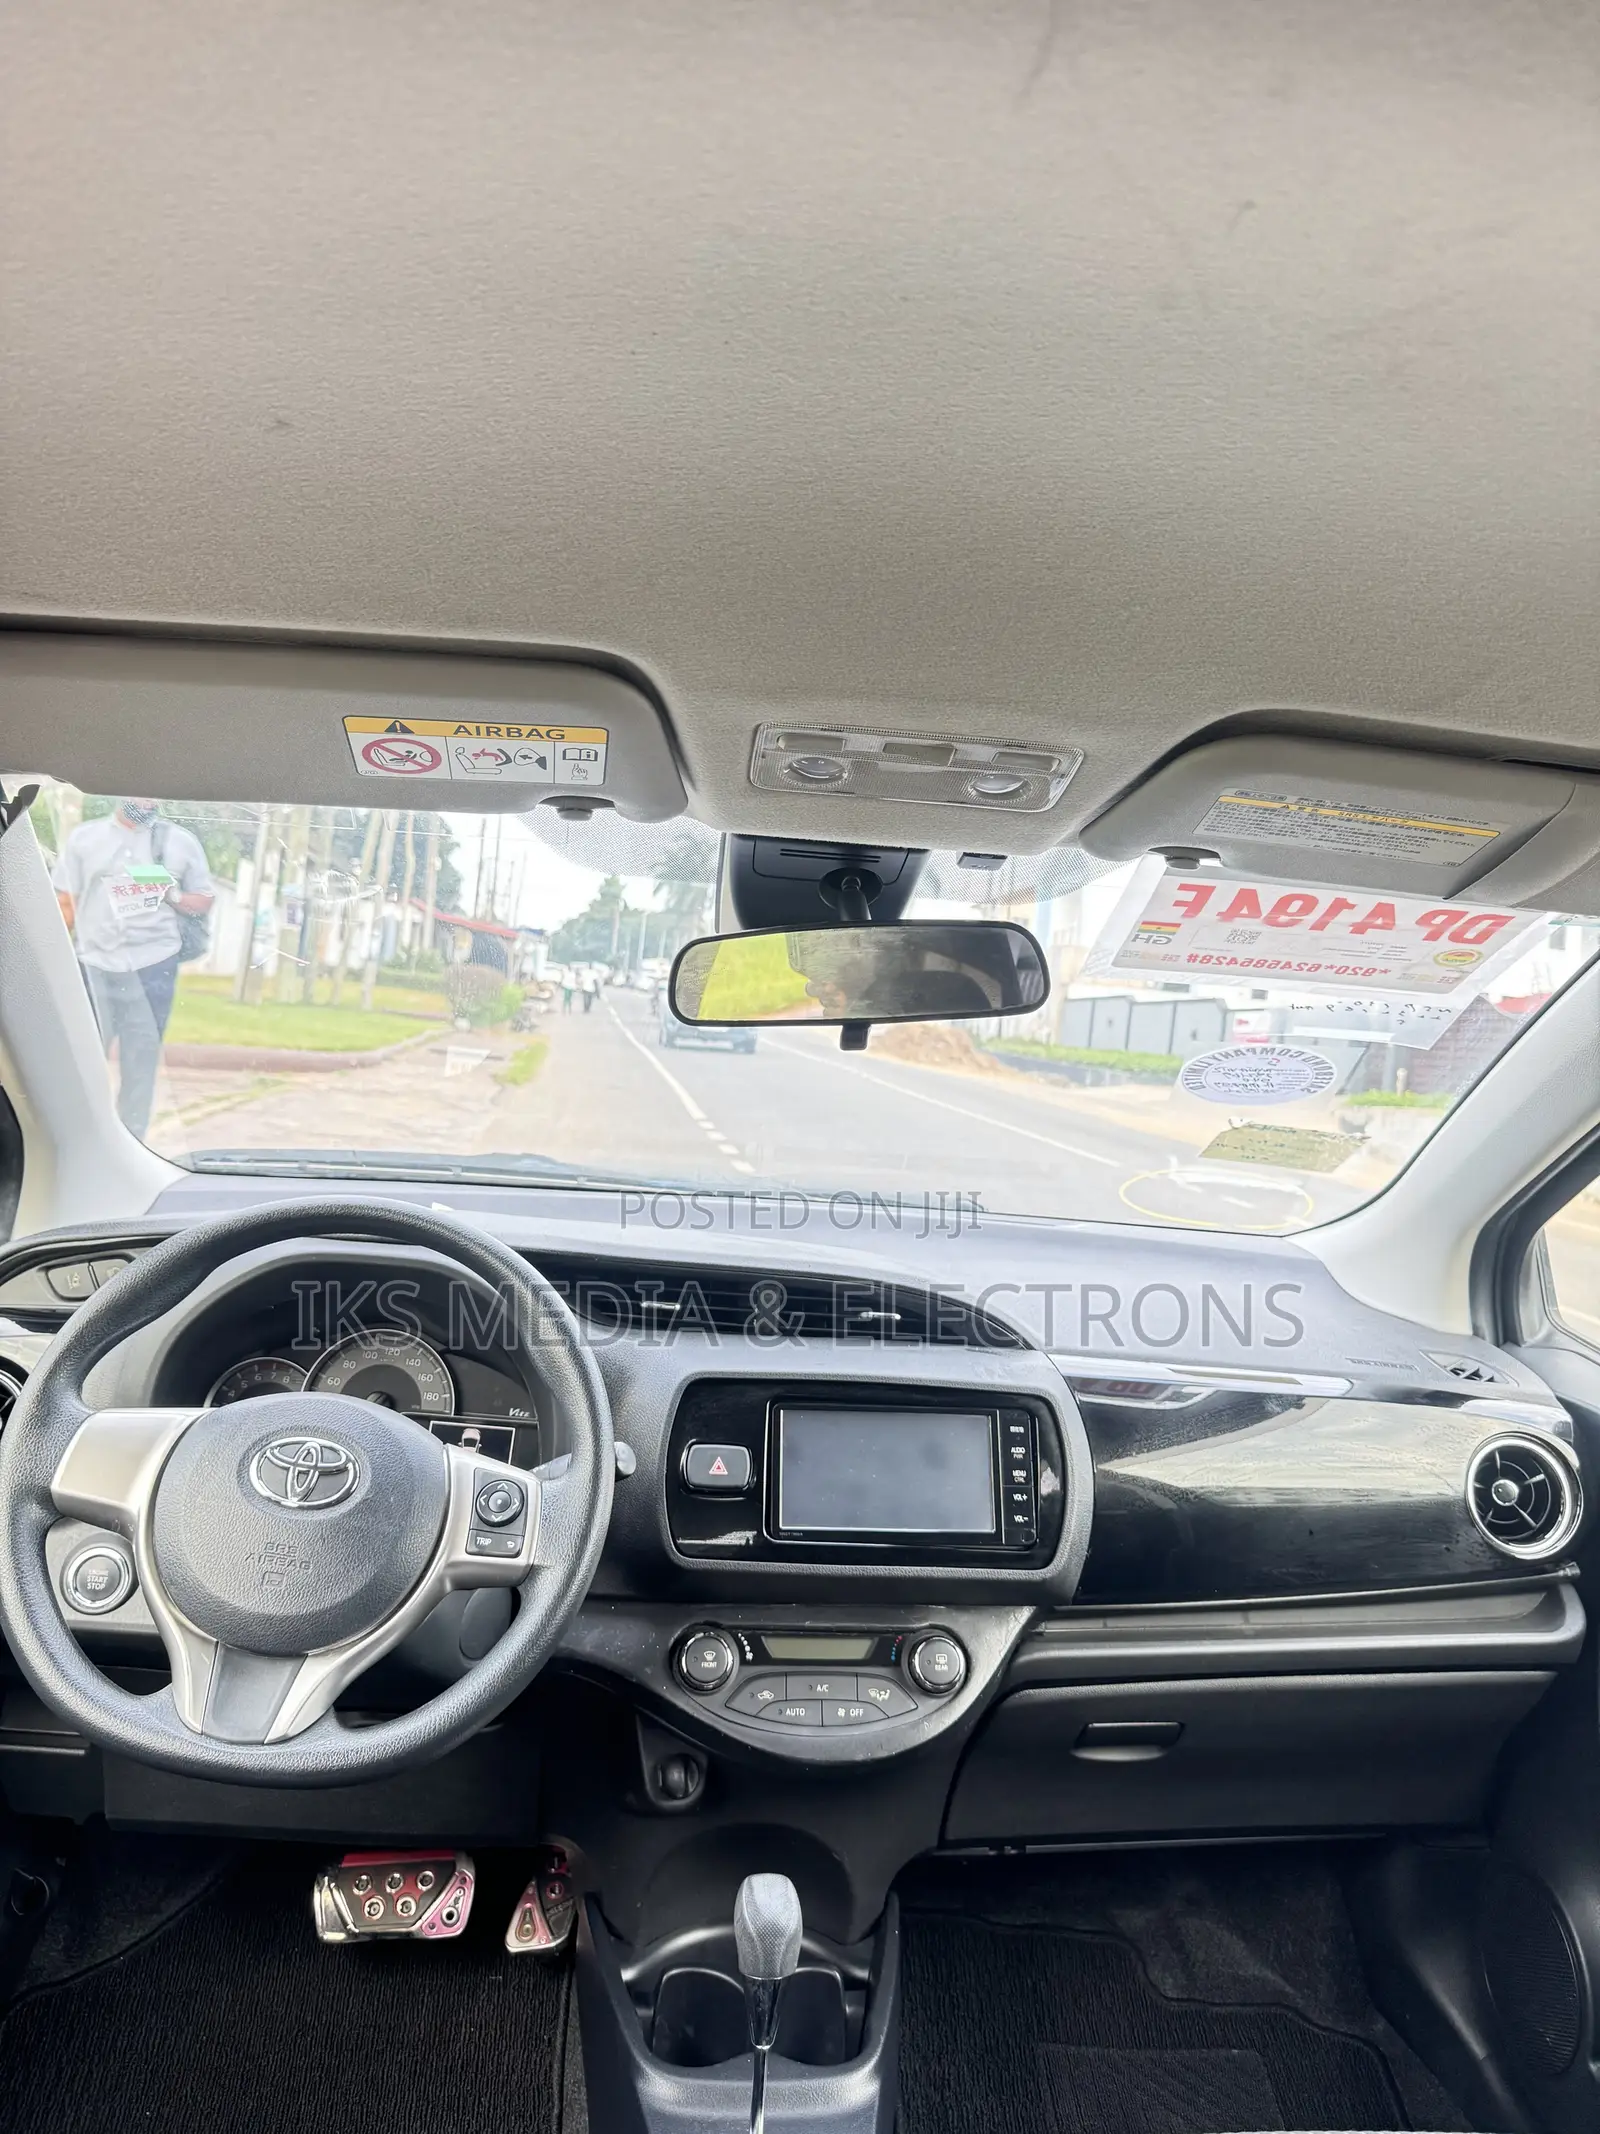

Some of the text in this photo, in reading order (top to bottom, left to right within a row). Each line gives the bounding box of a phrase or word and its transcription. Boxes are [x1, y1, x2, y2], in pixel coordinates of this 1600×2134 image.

[453, 724, 566, 740] AIRBAG
[362, 1350, 379, 1360] 100
[384, 1347, 401, 1356] 120
[342, 1359, 357, 1370] 80
[405, 1358, 421, 1367] 140
[254, 1373, 262, 1381] 6
[269, 1371, 277, 1380] 7
[282, 1375, 290, 1384] 8
[418, 1373, 434, 1383] 160
[326, 1375, 341, 1386] 60
[422, 1391, 440, 1402] 180
[476, 1537, 492, 1546] TRIP
[701, 1660, 717, 1668] FRONT
[934, 1663, 949, 1671] REAR
[816, 1683, 829, 1692] A/C
[785, 1706, 806, 1717] AUTO
[849, 1706, 864, 1717] OFF
